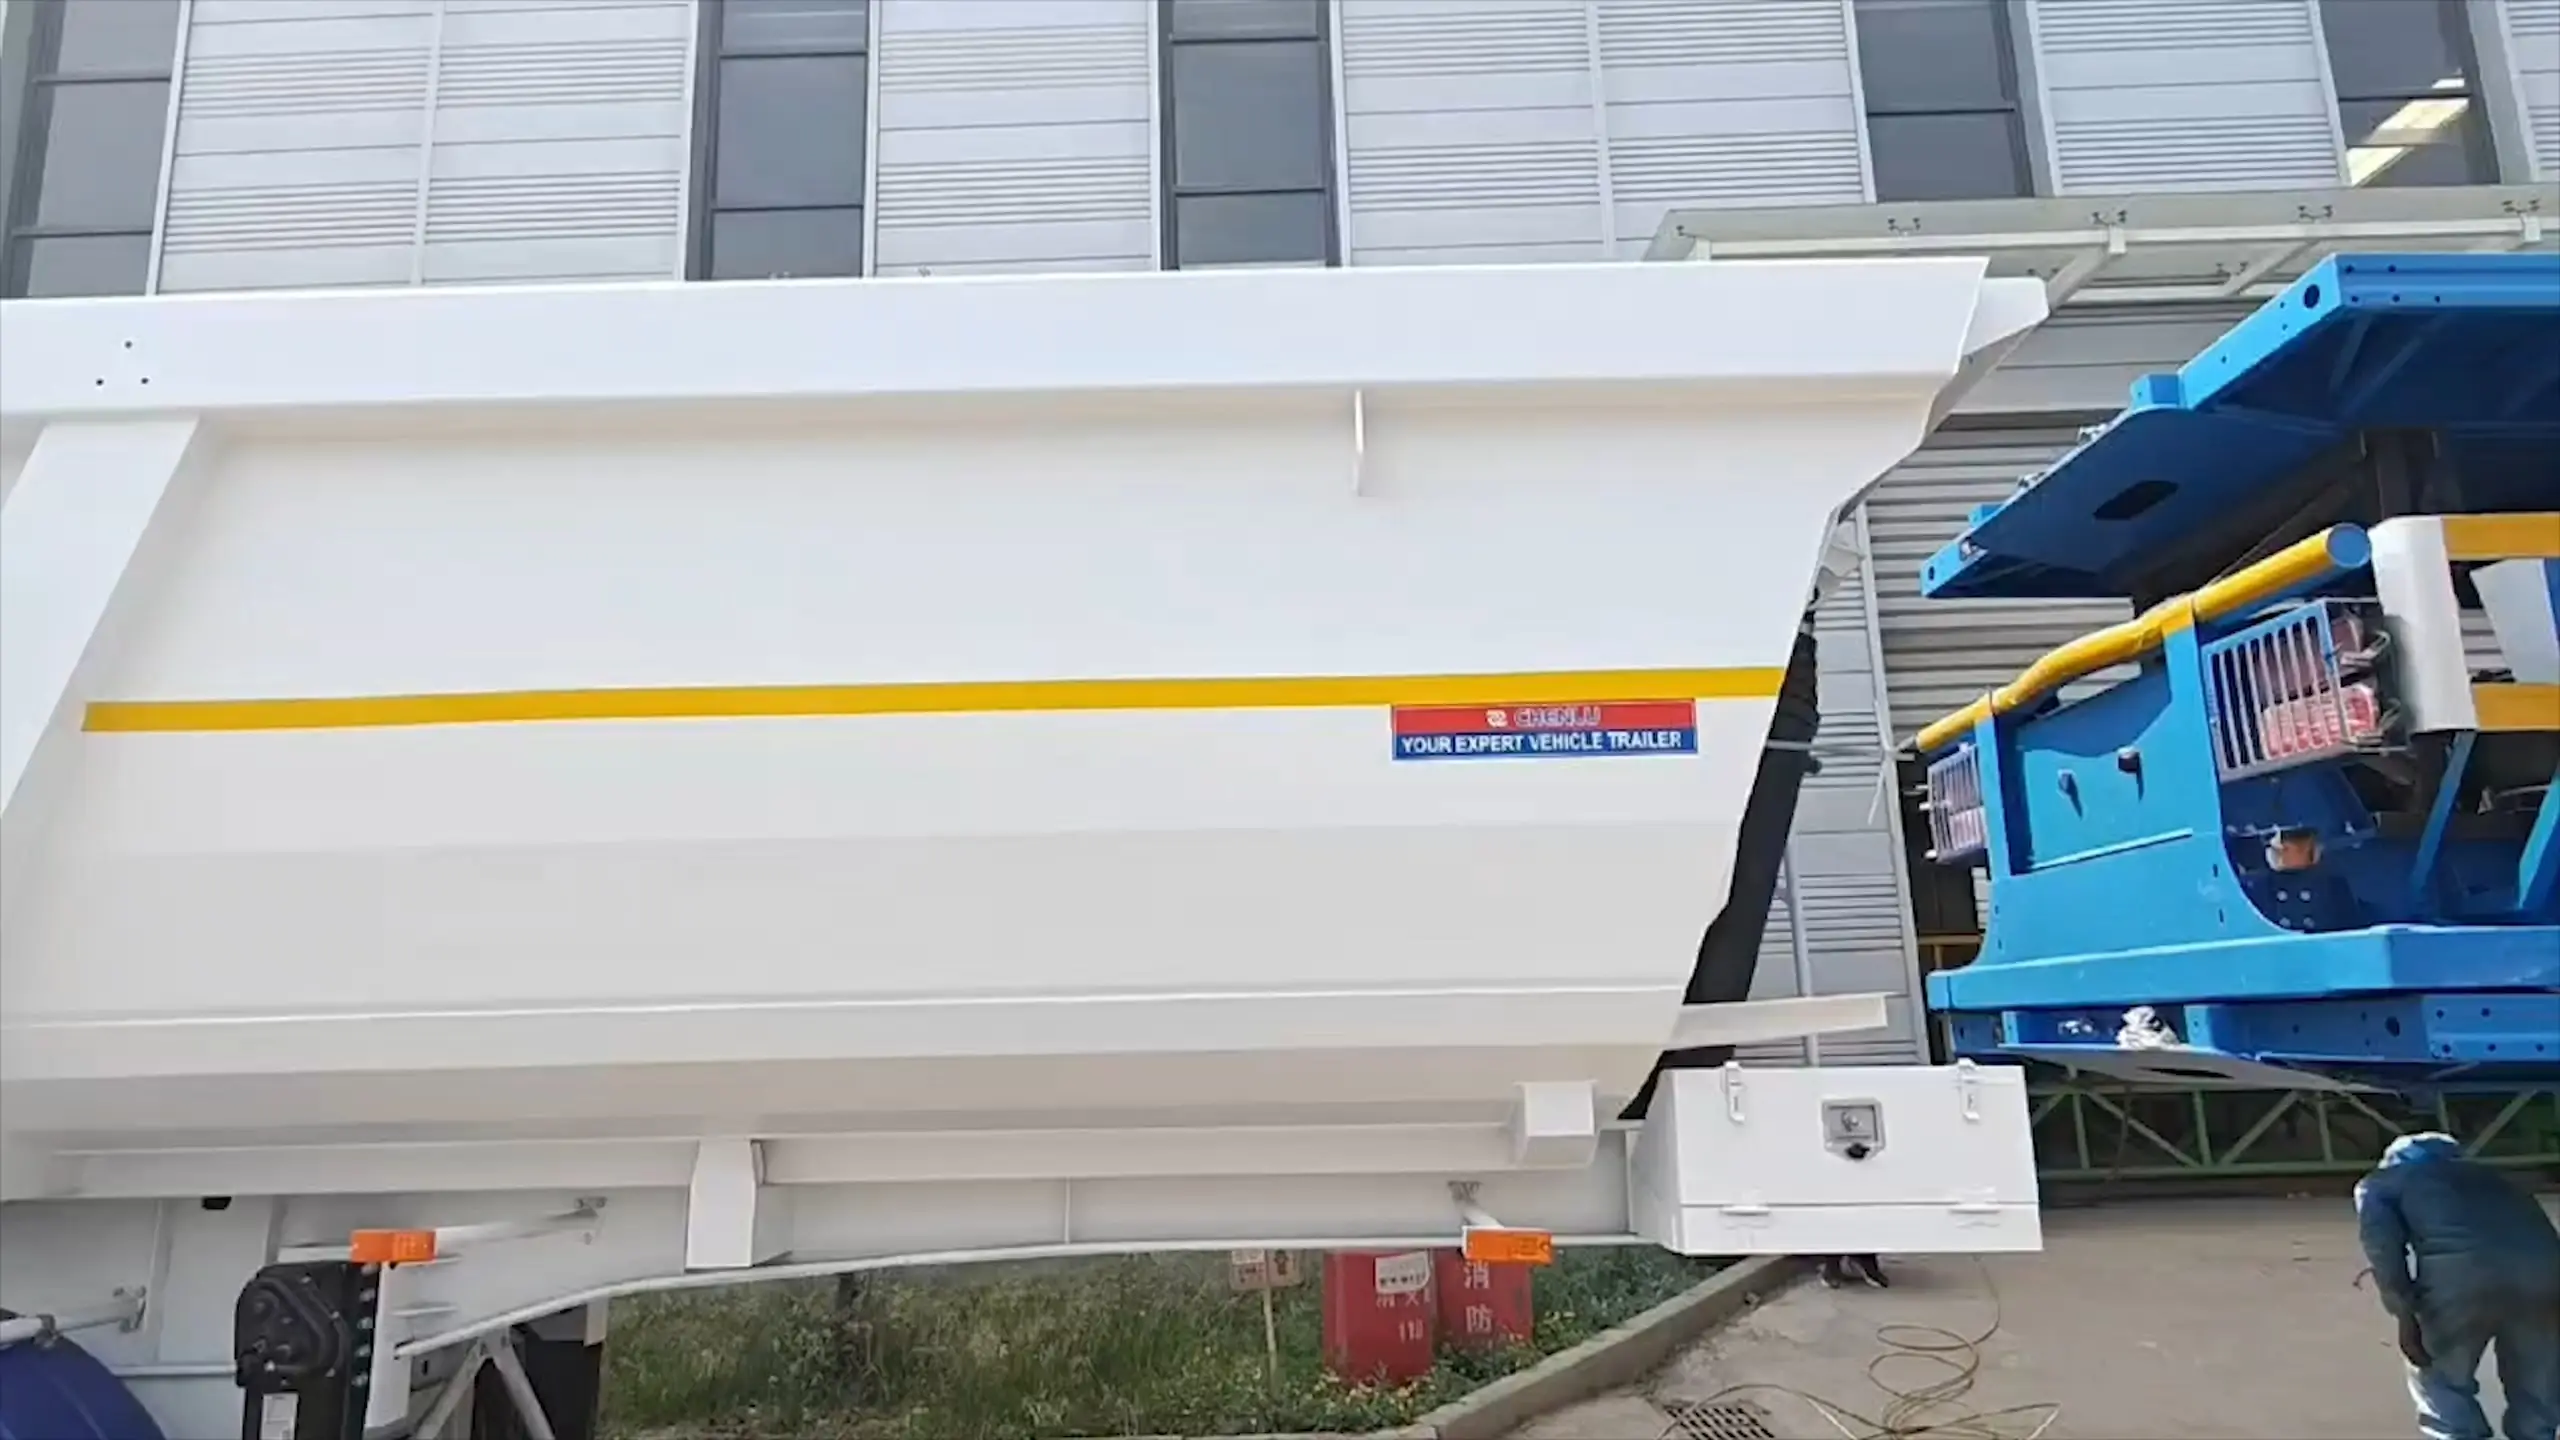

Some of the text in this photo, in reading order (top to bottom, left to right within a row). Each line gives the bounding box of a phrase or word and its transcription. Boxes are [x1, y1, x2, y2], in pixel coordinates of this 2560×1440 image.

[1513, 705, 1602, 727] CHENLU
[1400, 730, 1682, 753] YOUR EXPERT VEHICLE TRAILER
